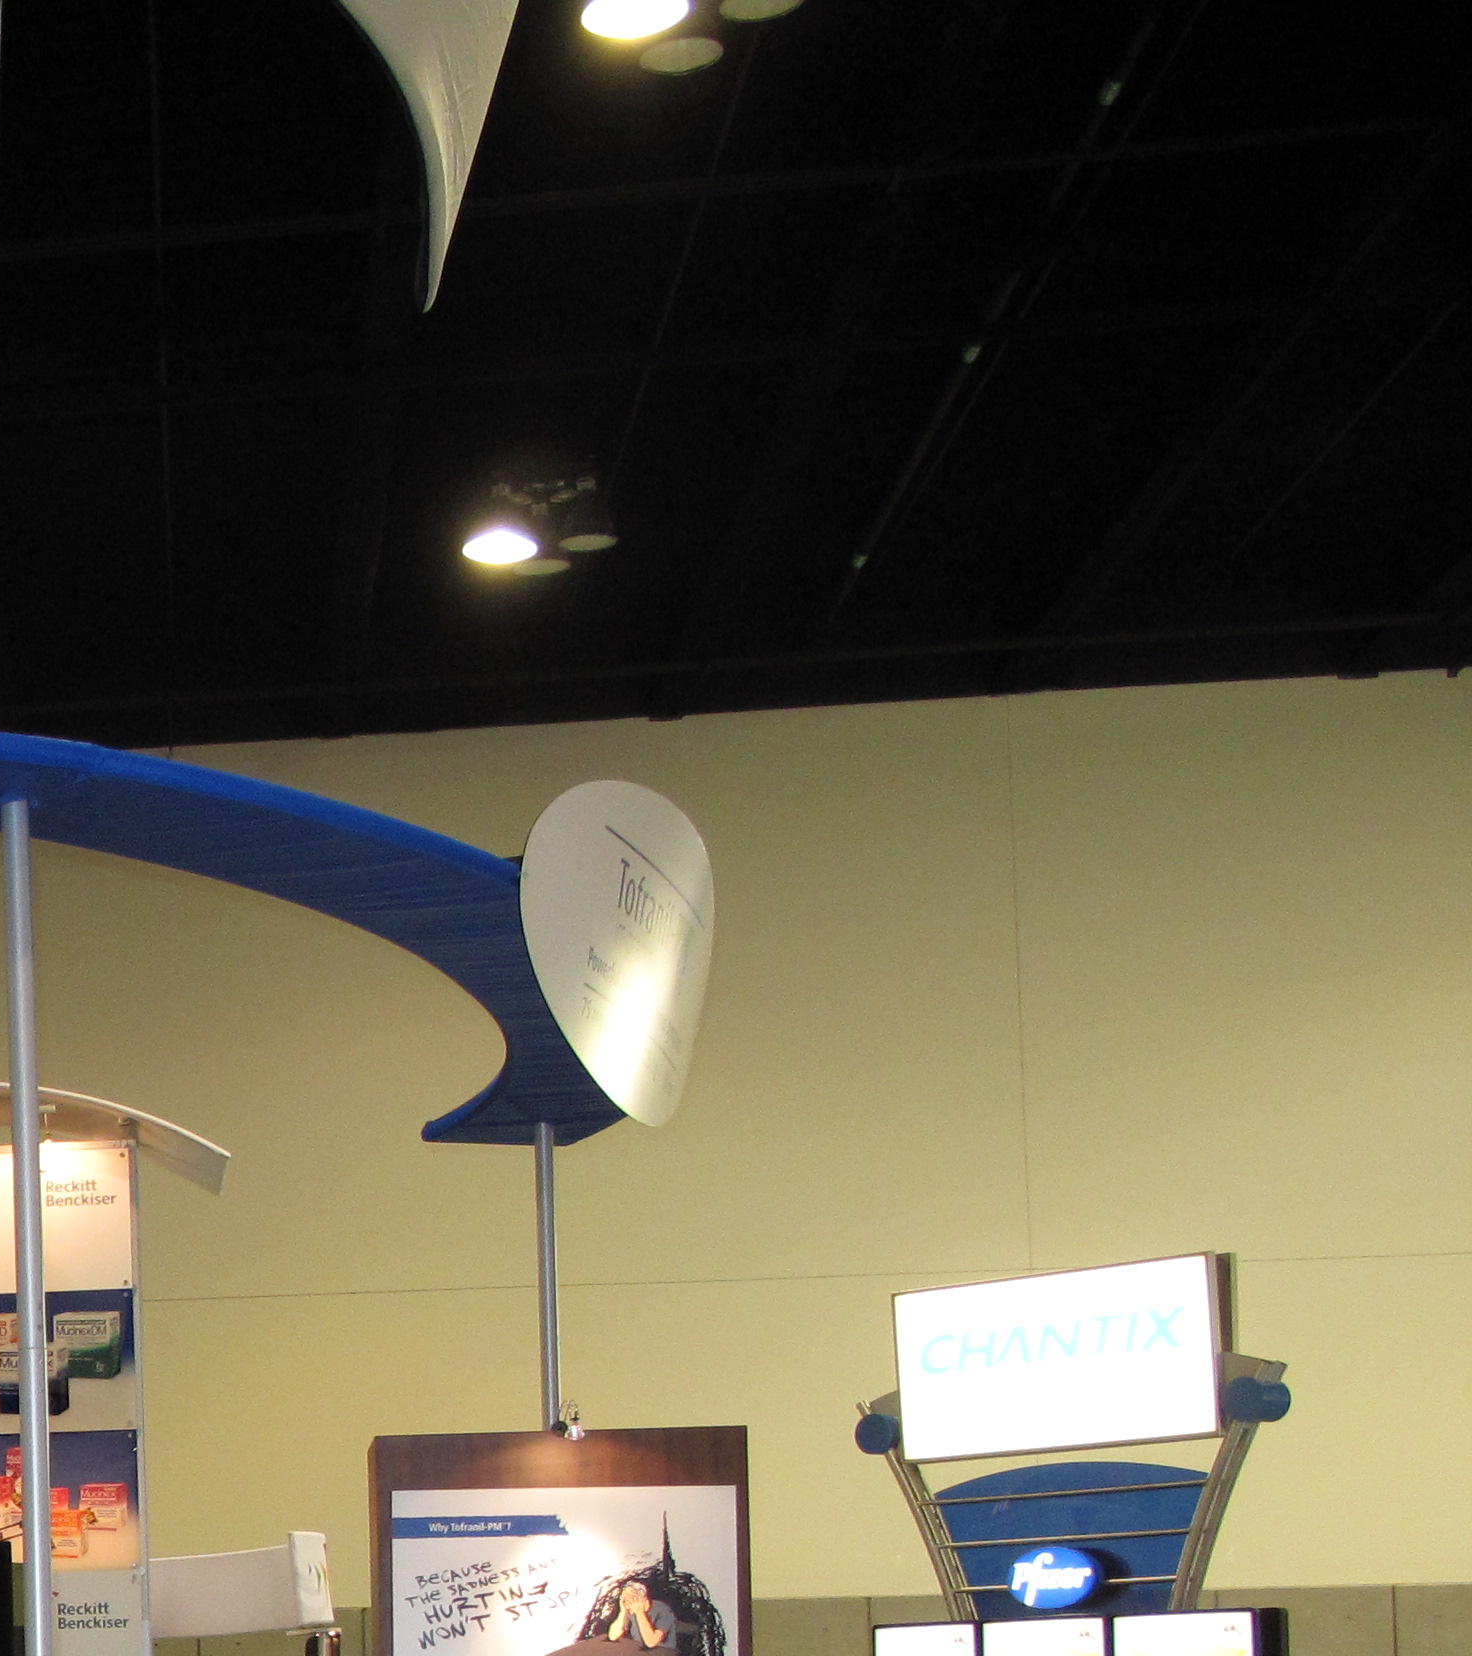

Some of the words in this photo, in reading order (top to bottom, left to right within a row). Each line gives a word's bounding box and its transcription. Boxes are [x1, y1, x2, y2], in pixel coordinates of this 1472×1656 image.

[45, 1178, 97, 1193] Reckitt
[45, 1192, 117, 1207] Benckiser
[920, 1305, 1184, 1375] CHANTIX
[80, 1489, 116, 1497] Mucinex
[428, 1523, 449, 1533] Why
[414, 1561, 492, 1589] BECAUSE
[1010, 1552, 1092, 1607] Pfizer
[404, 1589, 442, 1608] THE
[446, 1566, 521, 1597] SADNESS
[57, 1602, 110, 1616] Reckitt
[423, 1580, 549, 1625] HURTING
[57, 1616, 129, 1630] Benckiser
[417, 1612, 491, 1650] WON'T
